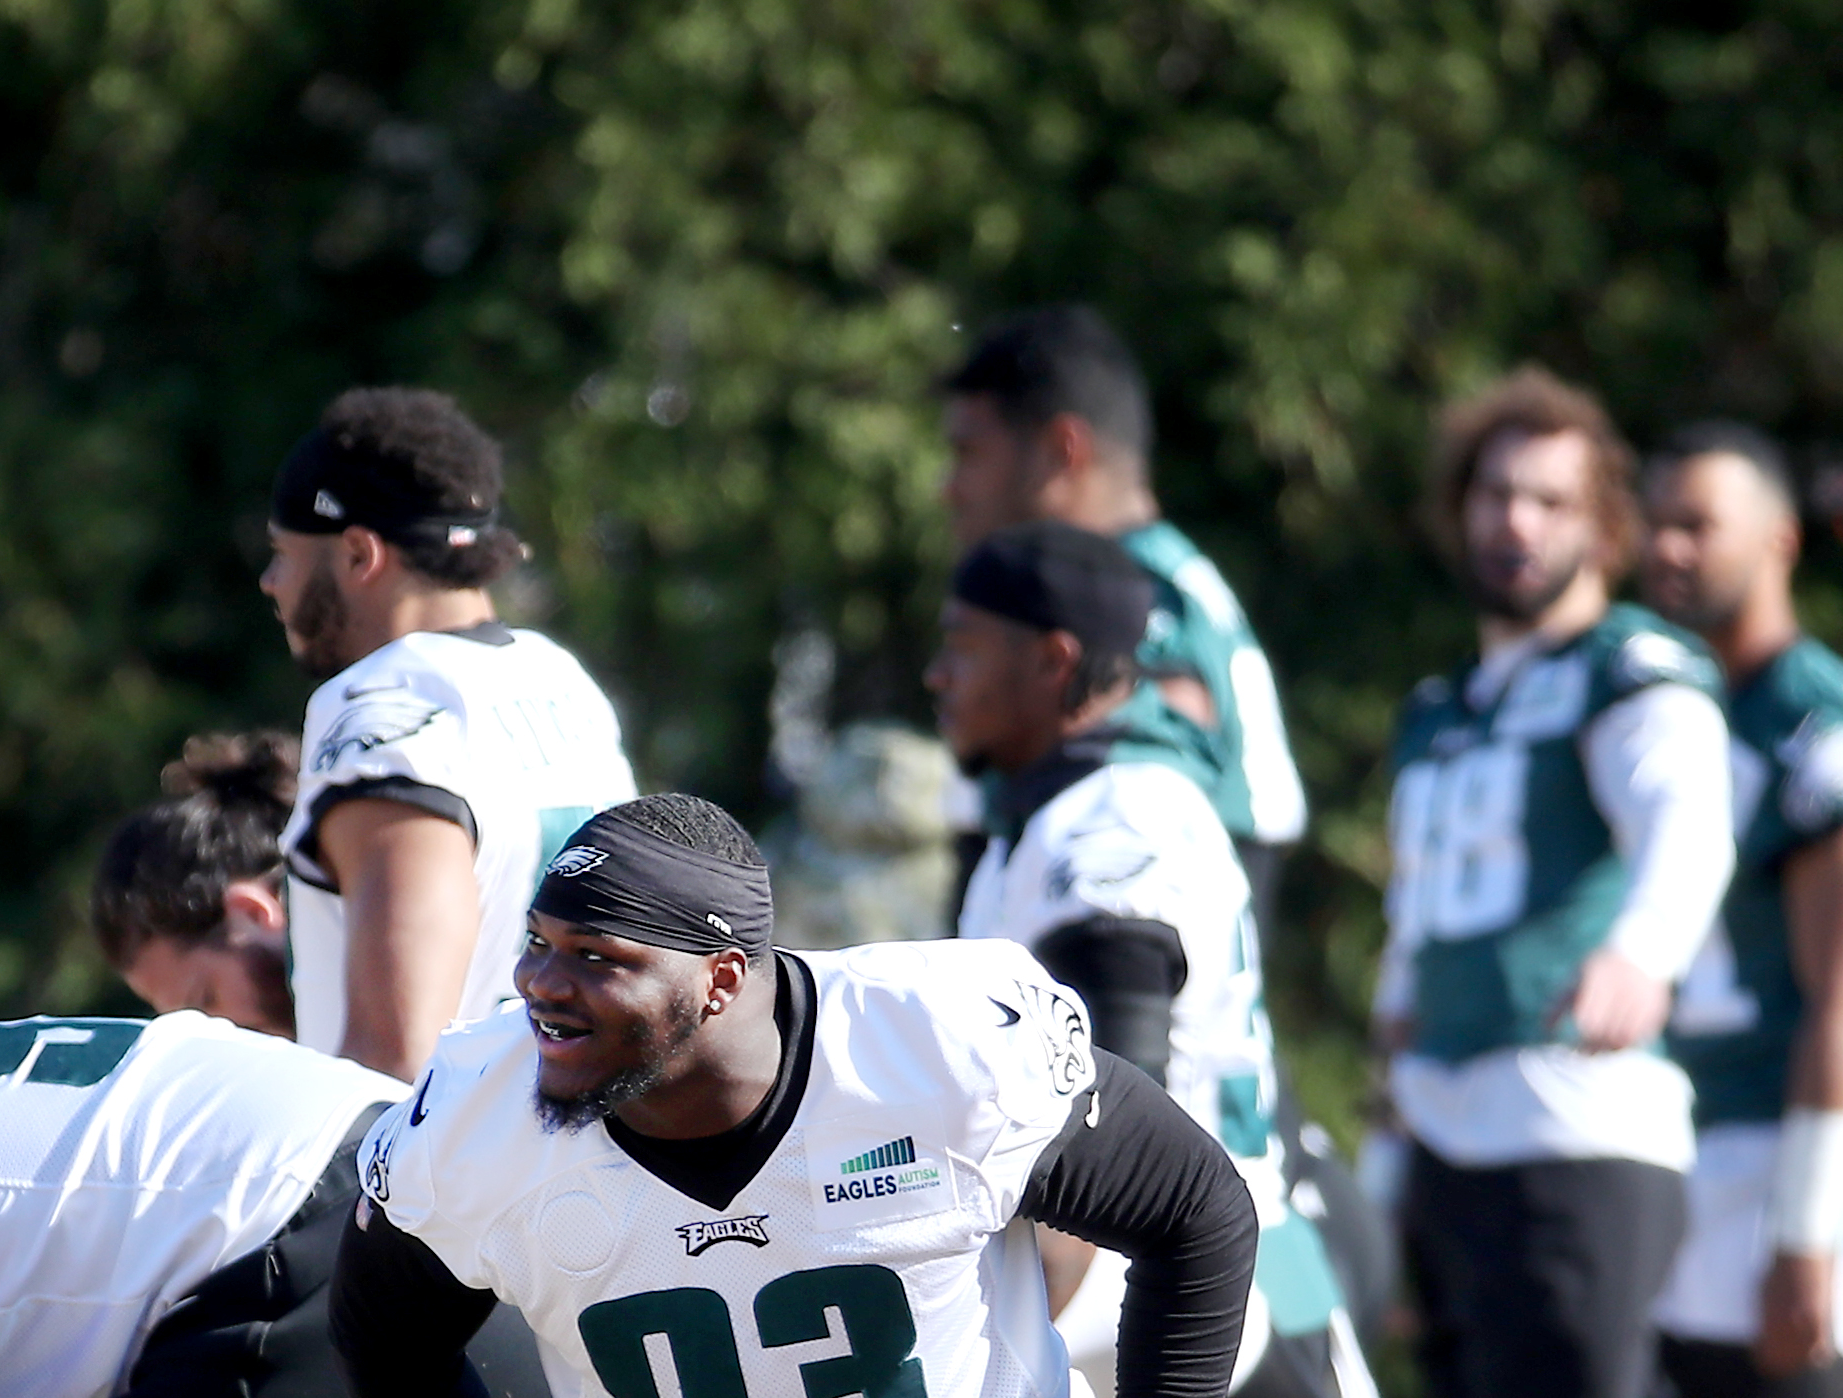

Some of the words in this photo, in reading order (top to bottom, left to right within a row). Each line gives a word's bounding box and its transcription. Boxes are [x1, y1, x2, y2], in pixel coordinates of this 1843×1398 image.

[823, 1174, 897, 1204] EAGLES
[898, 1167, 939, 1184] AUTISM
[898, 1180, 941, 1193] FOUNDATION
[675, 1214, 770, 1257] EAGLES
